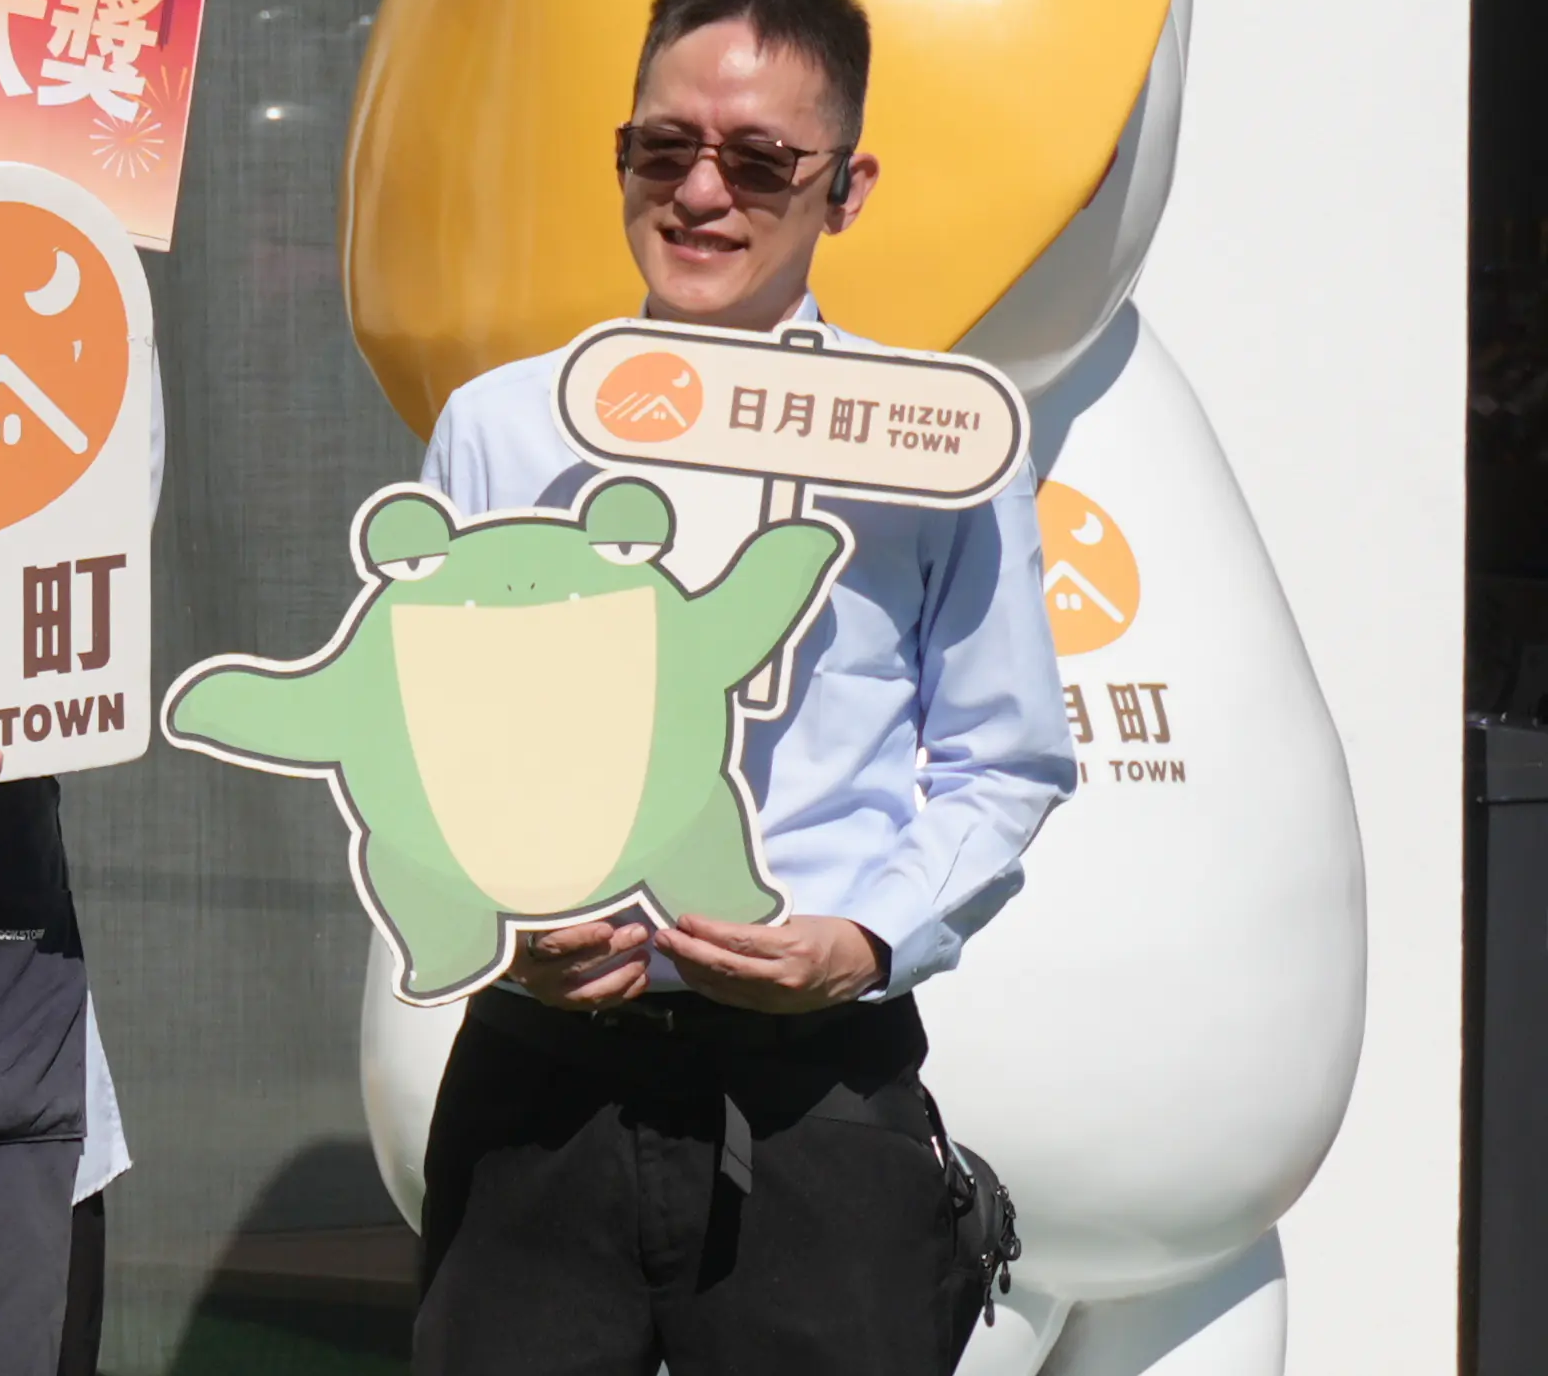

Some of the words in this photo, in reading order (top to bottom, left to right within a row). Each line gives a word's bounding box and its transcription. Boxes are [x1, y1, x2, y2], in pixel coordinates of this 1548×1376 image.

[729, 386, 880, 444] 日月町
[889, 403, 981, 431] HIZUKI
[887, 428, 961, 455] TOWN
[1109, 760, 1186, 784] TOWN
